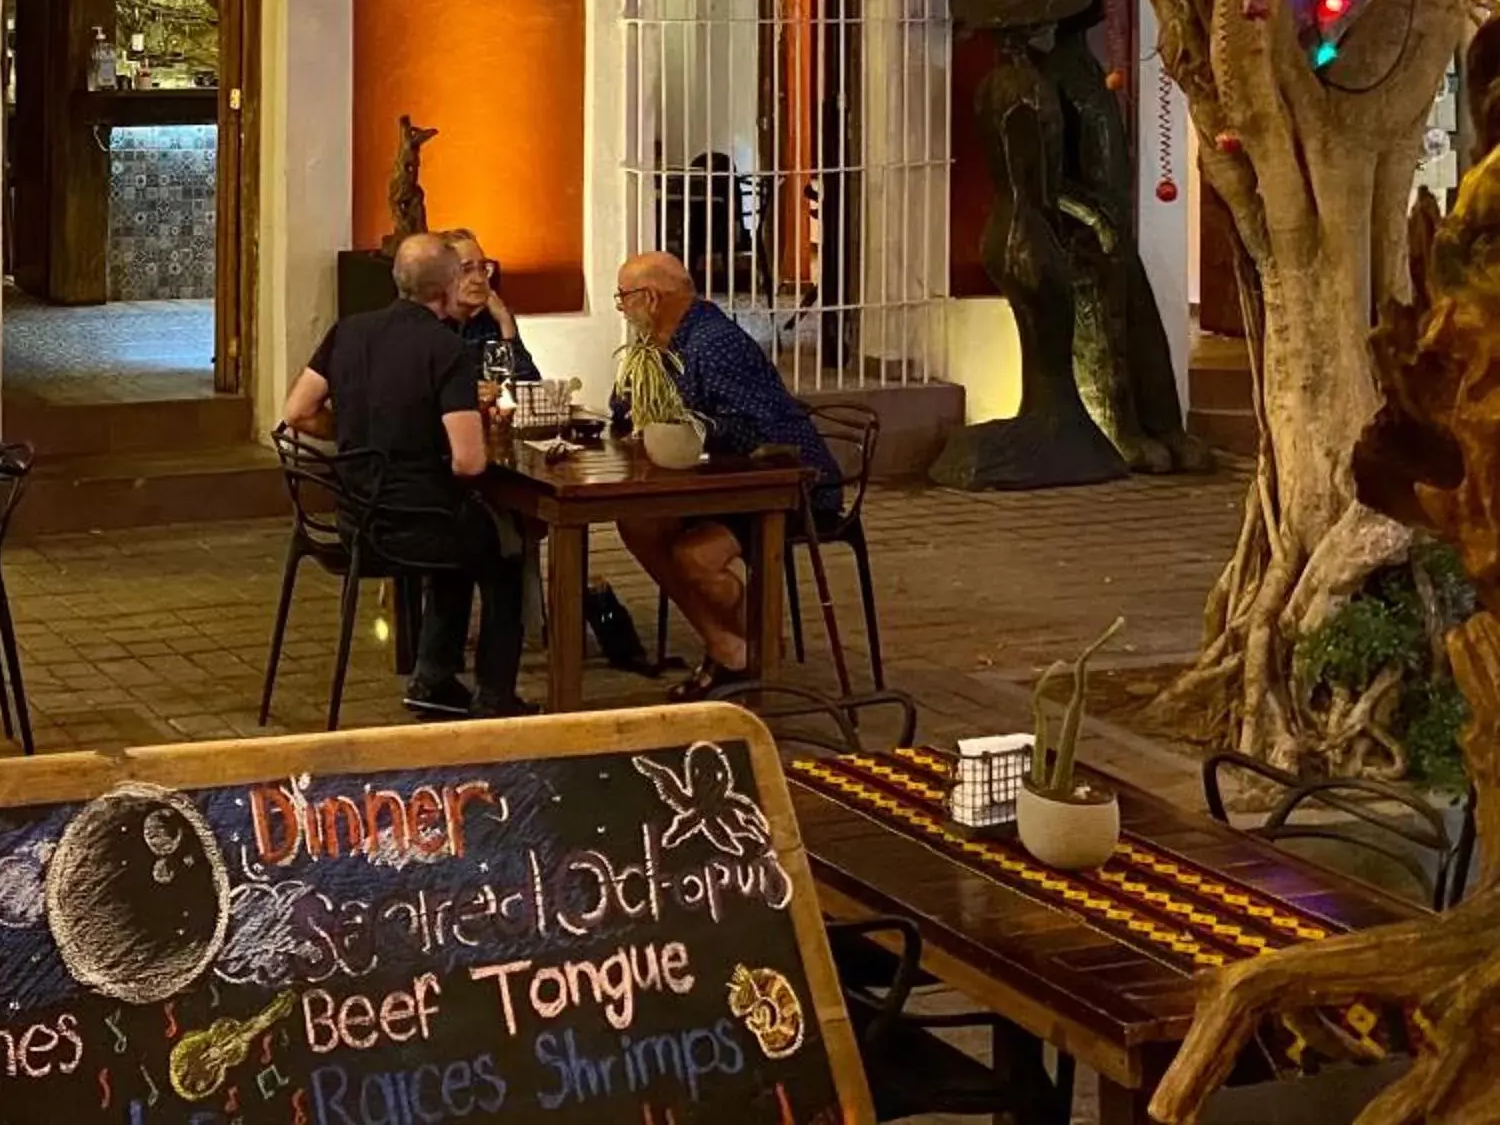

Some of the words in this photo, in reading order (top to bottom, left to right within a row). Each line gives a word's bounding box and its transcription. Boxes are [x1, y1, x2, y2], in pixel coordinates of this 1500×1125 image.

[250, 772, 505, 867] Dinner
[302, 972, 441, 1054] Beef
[470, 939, 695, 1036] Tongue
[536, 1019, 745, 1108] Shrimps
